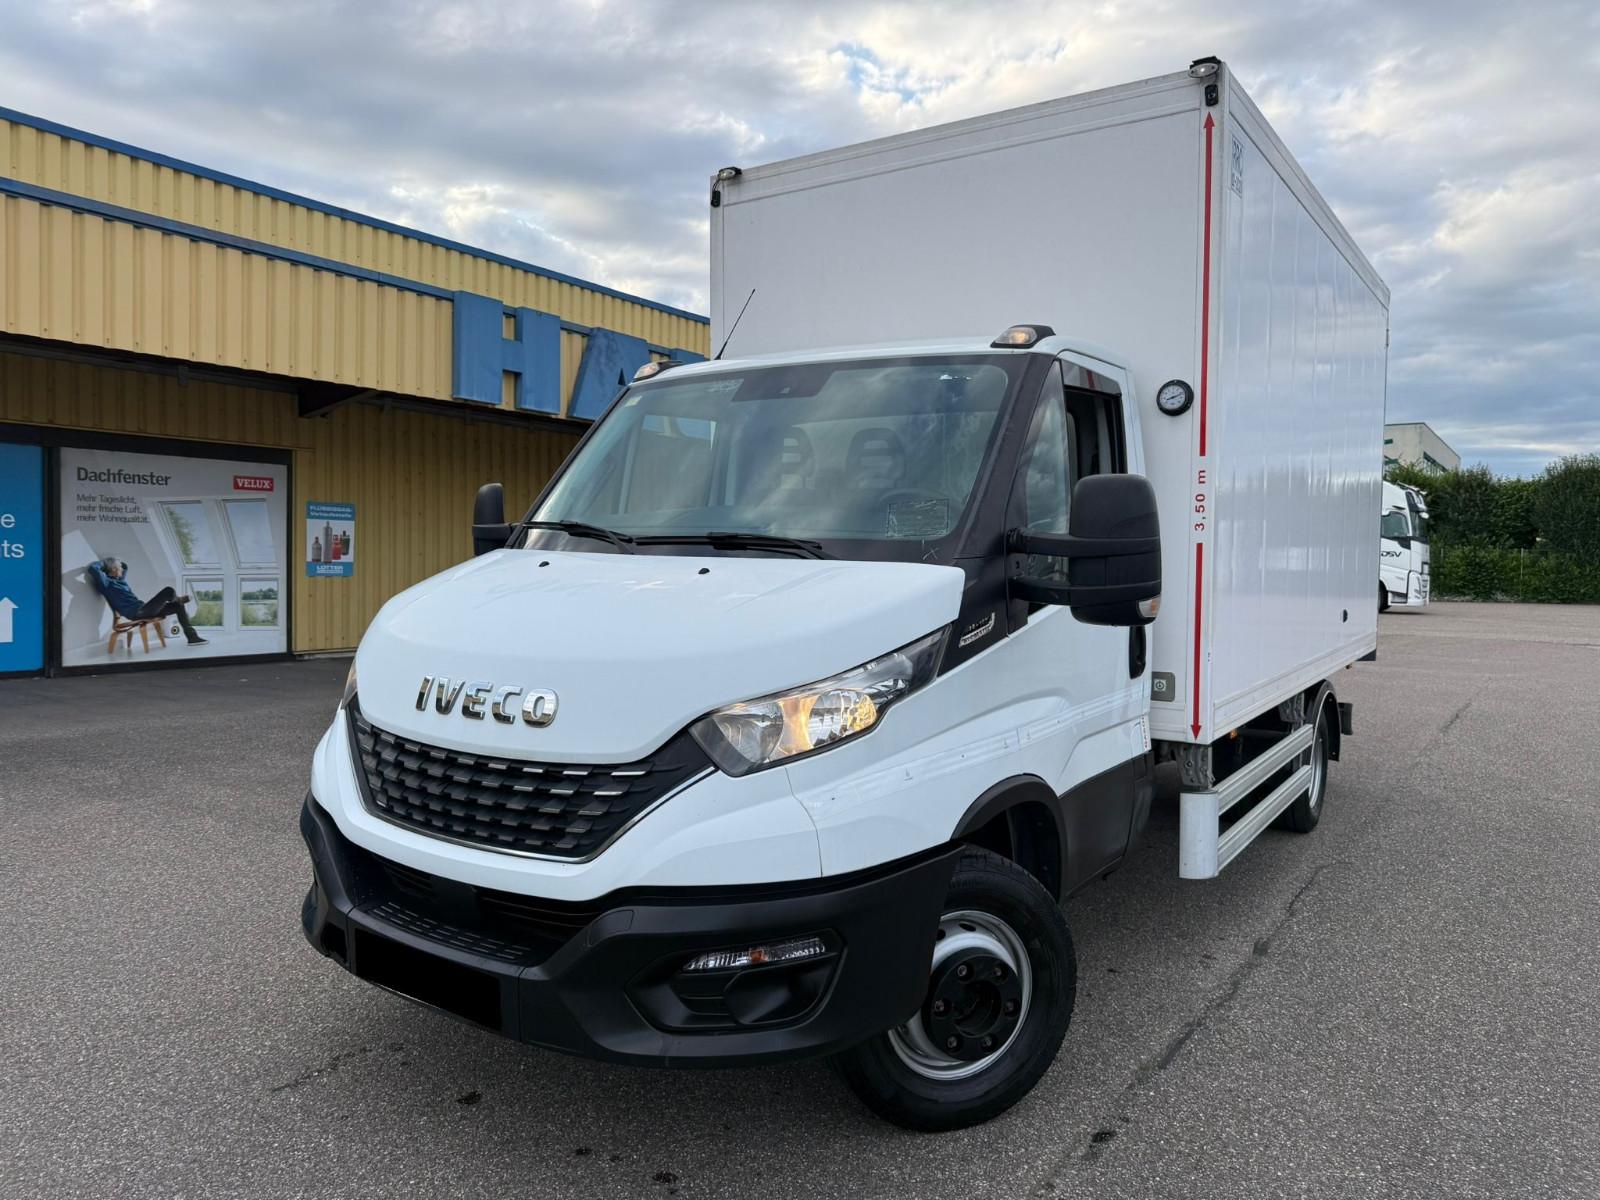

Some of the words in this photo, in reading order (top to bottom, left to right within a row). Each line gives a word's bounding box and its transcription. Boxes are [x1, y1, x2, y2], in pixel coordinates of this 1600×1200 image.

[76, 466, 172, 486] Dachfenster
[236, 478, 271, 489] VELUX
[1198, 469, 1206, 484] m
[76, 493, 96, 503] Mehr
[76, 504, 96, 512] mehr
[1194, 493, 1206, 532] 3,50
[0, 539, 25, 558] ts
[1380, 550, 1402, 558] DSV
[415, 672, 560, 729] IVECO
